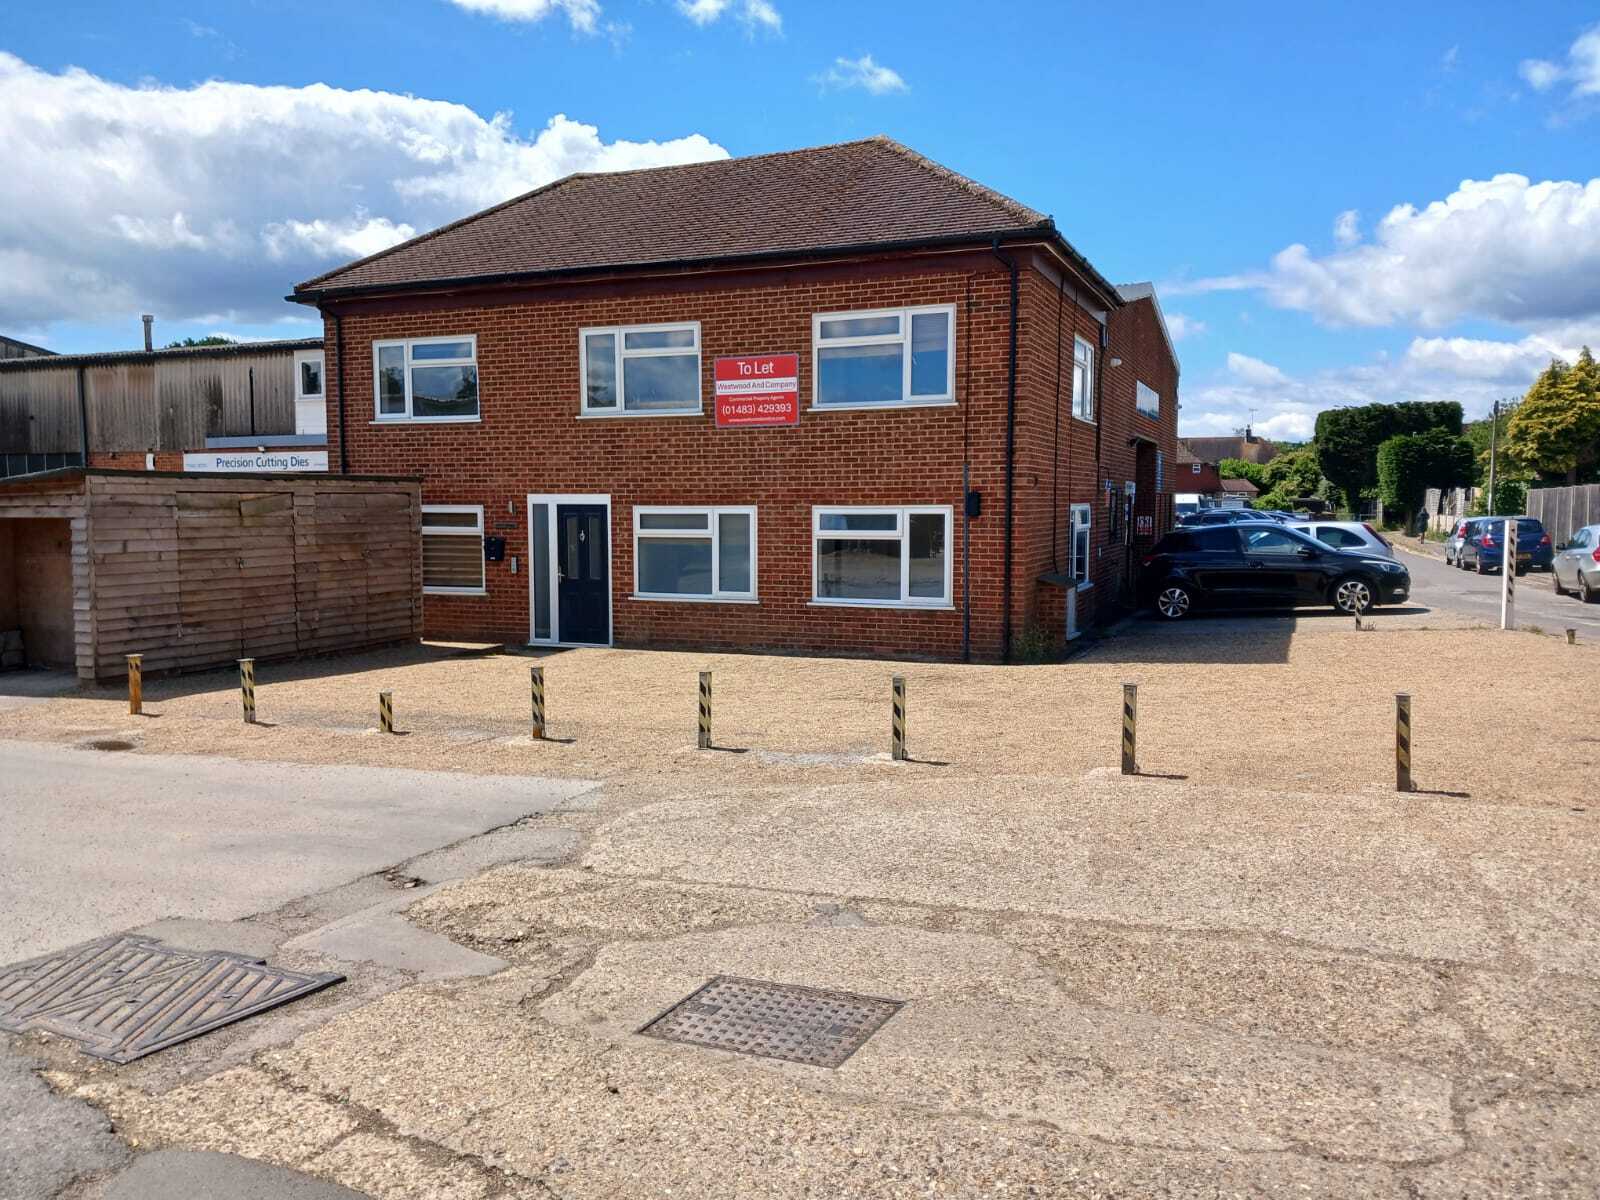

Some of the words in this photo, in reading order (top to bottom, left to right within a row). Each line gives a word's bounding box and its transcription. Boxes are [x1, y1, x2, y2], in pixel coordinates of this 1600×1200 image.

[736, 361, 752, 376] To
[754, 361, 774, 374] Let
[718, 382, 751, 391] Westwood
[752, 380, 765, 389] And
[765, 380, 796, 390] Company
[722, 403, 756, 416] (01483)
[757, 403, 792, 413] 429393
[216, 456, 254, 468] Precision
[255, 456, 289, 469] Cutting
[290, 456, 310, 467] Dies
